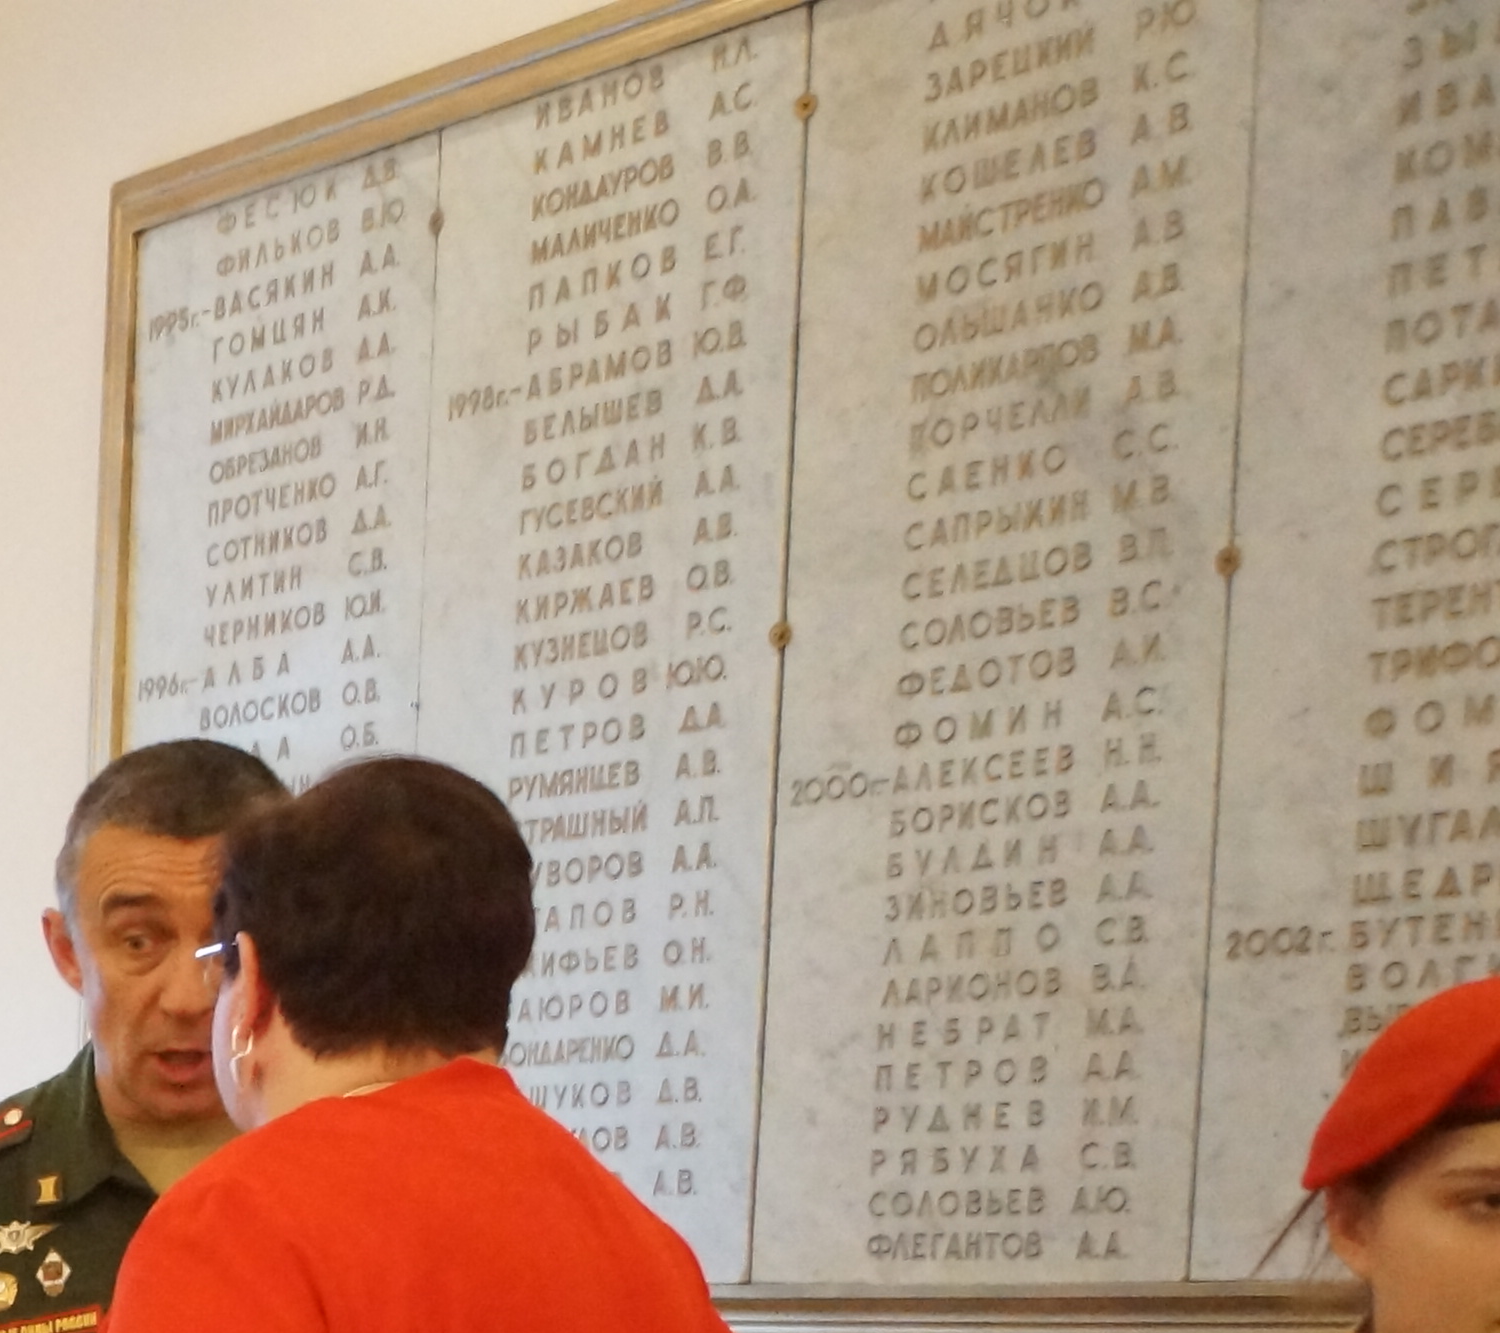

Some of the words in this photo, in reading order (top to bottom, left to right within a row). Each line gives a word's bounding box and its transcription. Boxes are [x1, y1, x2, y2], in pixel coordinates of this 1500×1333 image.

[534, 64, 666, 130] ИВАНОВ
[924, 76, 1098, 151] КЛИМАНОВ
[534, 110, 670, 175] КАМНЕВ
[921, 127, 1096, 204] КОШЕЛЕВ
[532, 154, 674, 222] КОНДАУРОВ
[217, 218, 340, 277] ФИЛЬКОВ
[531, 198, 678, 266] МАЛИЧЕНКО
[214, 261, 333, 321] ВАСЯКИН
[529, 246, 675, 310] ПАПКОВ
[917, 232, 1094, 303] МОСЯГИН
[213, 307, 324, 363] ГОМЦЯН
[528, 294, 670, 355] РЫБАК
[212, 347, 333, 403] КУЛАКОВ
[527, 339, 671, 401] АБРАМОВ
[911, 333, 1099, 403] ПОЛИКАРПОВ
[524, 390, 662, 446] БЕЛЫШЕВ
[522, 432, 665, 492] БОГДАН
[908, 444, 1066, 501] САЕНКО
[208, 472, 336, 527] ПРОТЧЕНКО
[520, 475, 662, 535] ГУСЕВСКИЙ
[904, 490, 1088, 551] САПРЫКИН
[207, 517, 327, 568] СОТНИКОВ
[517, 531, 642, 581] КАЗАКОВ
[206, 565, 301, 608] УЛИТИН
[903, 541, 1092, 602] СЕЛЕДЦОВ
[515, 574, 653, 624] КИРЖАЕВ
[900, 595, 1080, 653] СОЛОВЬЕВ
[204, 602, 325, 648] ЧЕРНИКОВ
[513, 621, 647, 671] КУЗНЕЦОВ
[203, 652, 290, 692] АЛБА
[512, 667, 647, 715] КУРОВ
[897, 646, 1076, 697] ФЕДОТОВ
[200, 688, 321, 732] ВОЛОСКОВ
[510, 713, 645, 758] ПЕТРОВ
[895, 700, 1062, 749] ФОМИН
[508, 760, 639, 803] РУМЯНЦЕВ
[893, 744, 1074, 795] АЛЕКСЕЕВ
[889, 790, 1071, 838] БОРИСКОВ
[887, 835, 1057, 878] БУЛДИН
[885, 878, 1066, 921] ЗИНОВЬЕВ
[882, 922, 1061, 967] ЛАППО
[881, 968, 1061, 1007] ЛАРИОНОВ
[877, 1012, 1050, 1051] НЕБРАТ
[875, 1056, 1046, 1091] ПЕТРОВ
[873, 1100, 1045, 1133] РУДНЕВ
[871, 1145, 1039, 1176] РЯБУХА
[868, 1186, 1045, 1217] СОЛОВЬЕВ
[867, 1232, 1044, 1261] ФЛЕГАНТОВ
